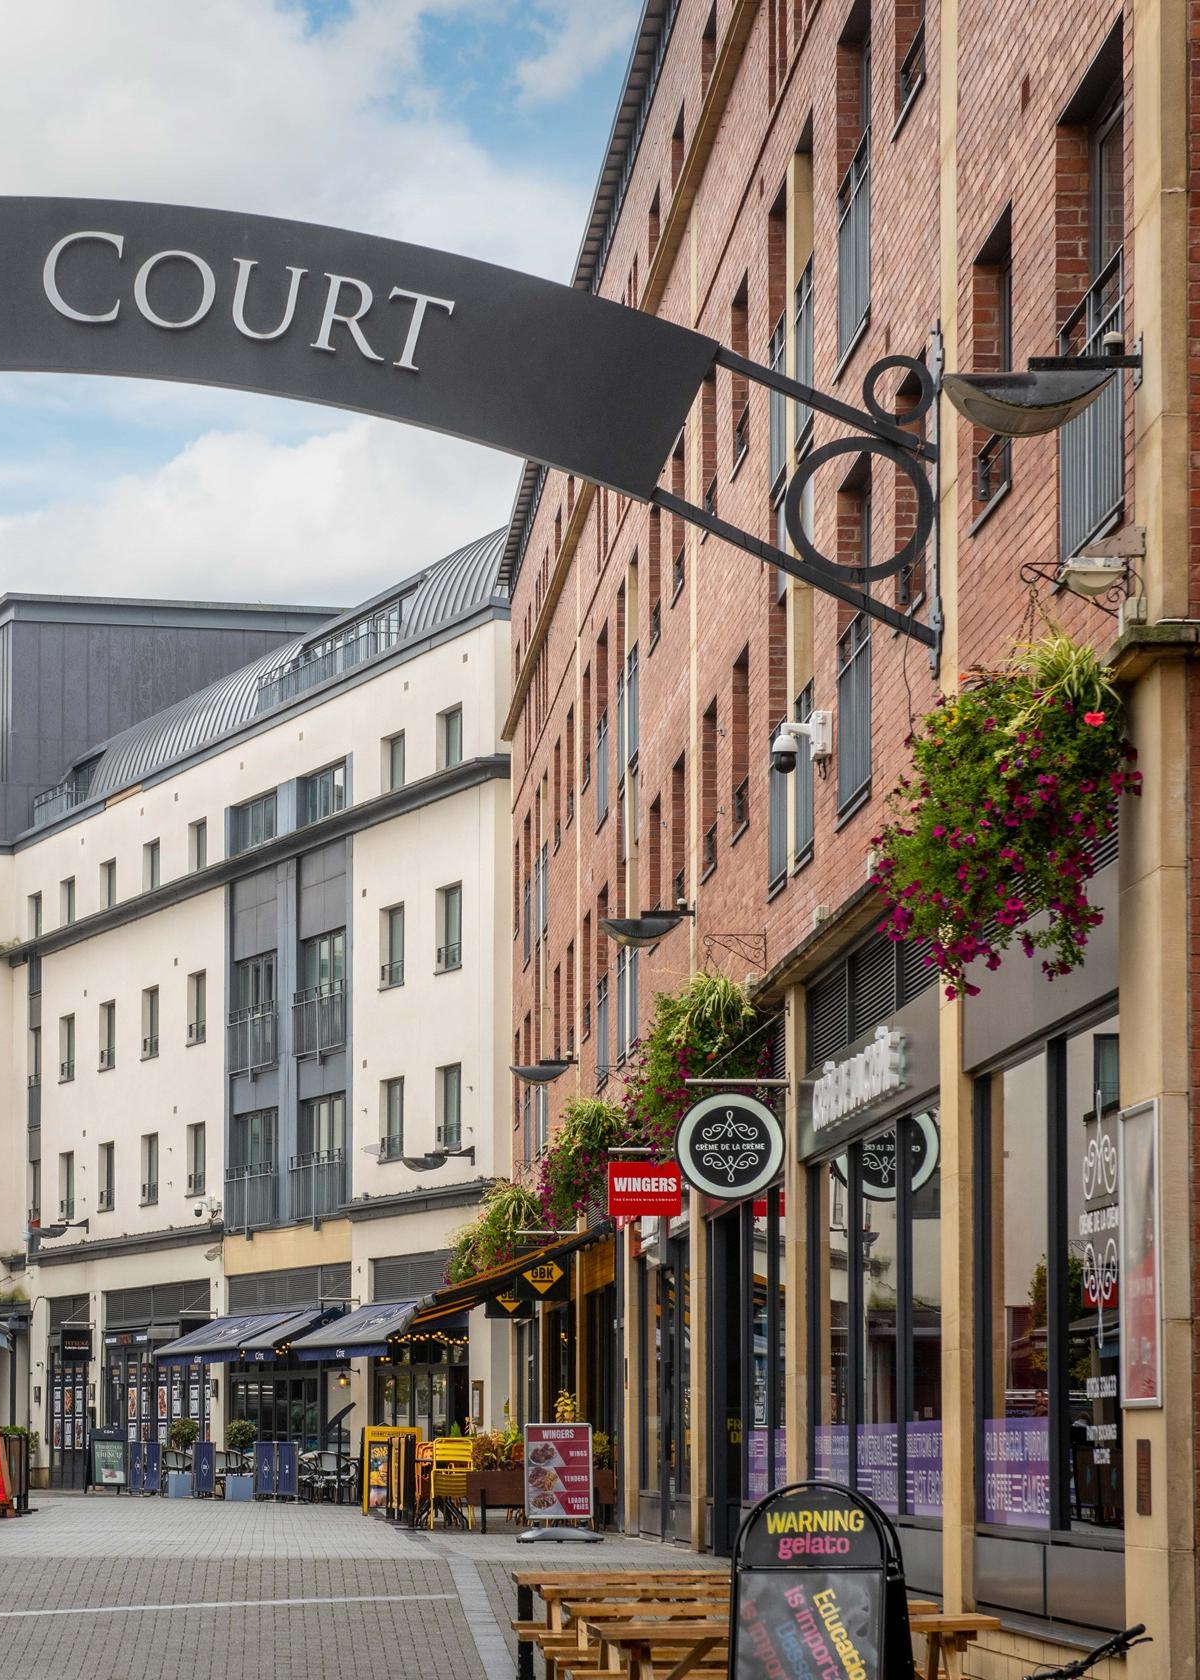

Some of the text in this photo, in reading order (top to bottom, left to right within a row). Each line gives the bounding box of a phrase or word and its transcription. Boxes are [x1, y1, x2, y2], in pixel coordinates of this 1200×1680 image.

[43, 231, 456, 372] COURT
[695, 1143, 718, 1151] CRÈME
[742, 1142, 765, 1150] CRÈME
[613, 1177, 677, 1192] WINGERS
[531, 1266, 554, 1279] GBK
[542, 1429, 575, 1440] WINGERS
[766, 1509, 865, 1534] WARNING
[778, 1532, 850, 1560] gelato
